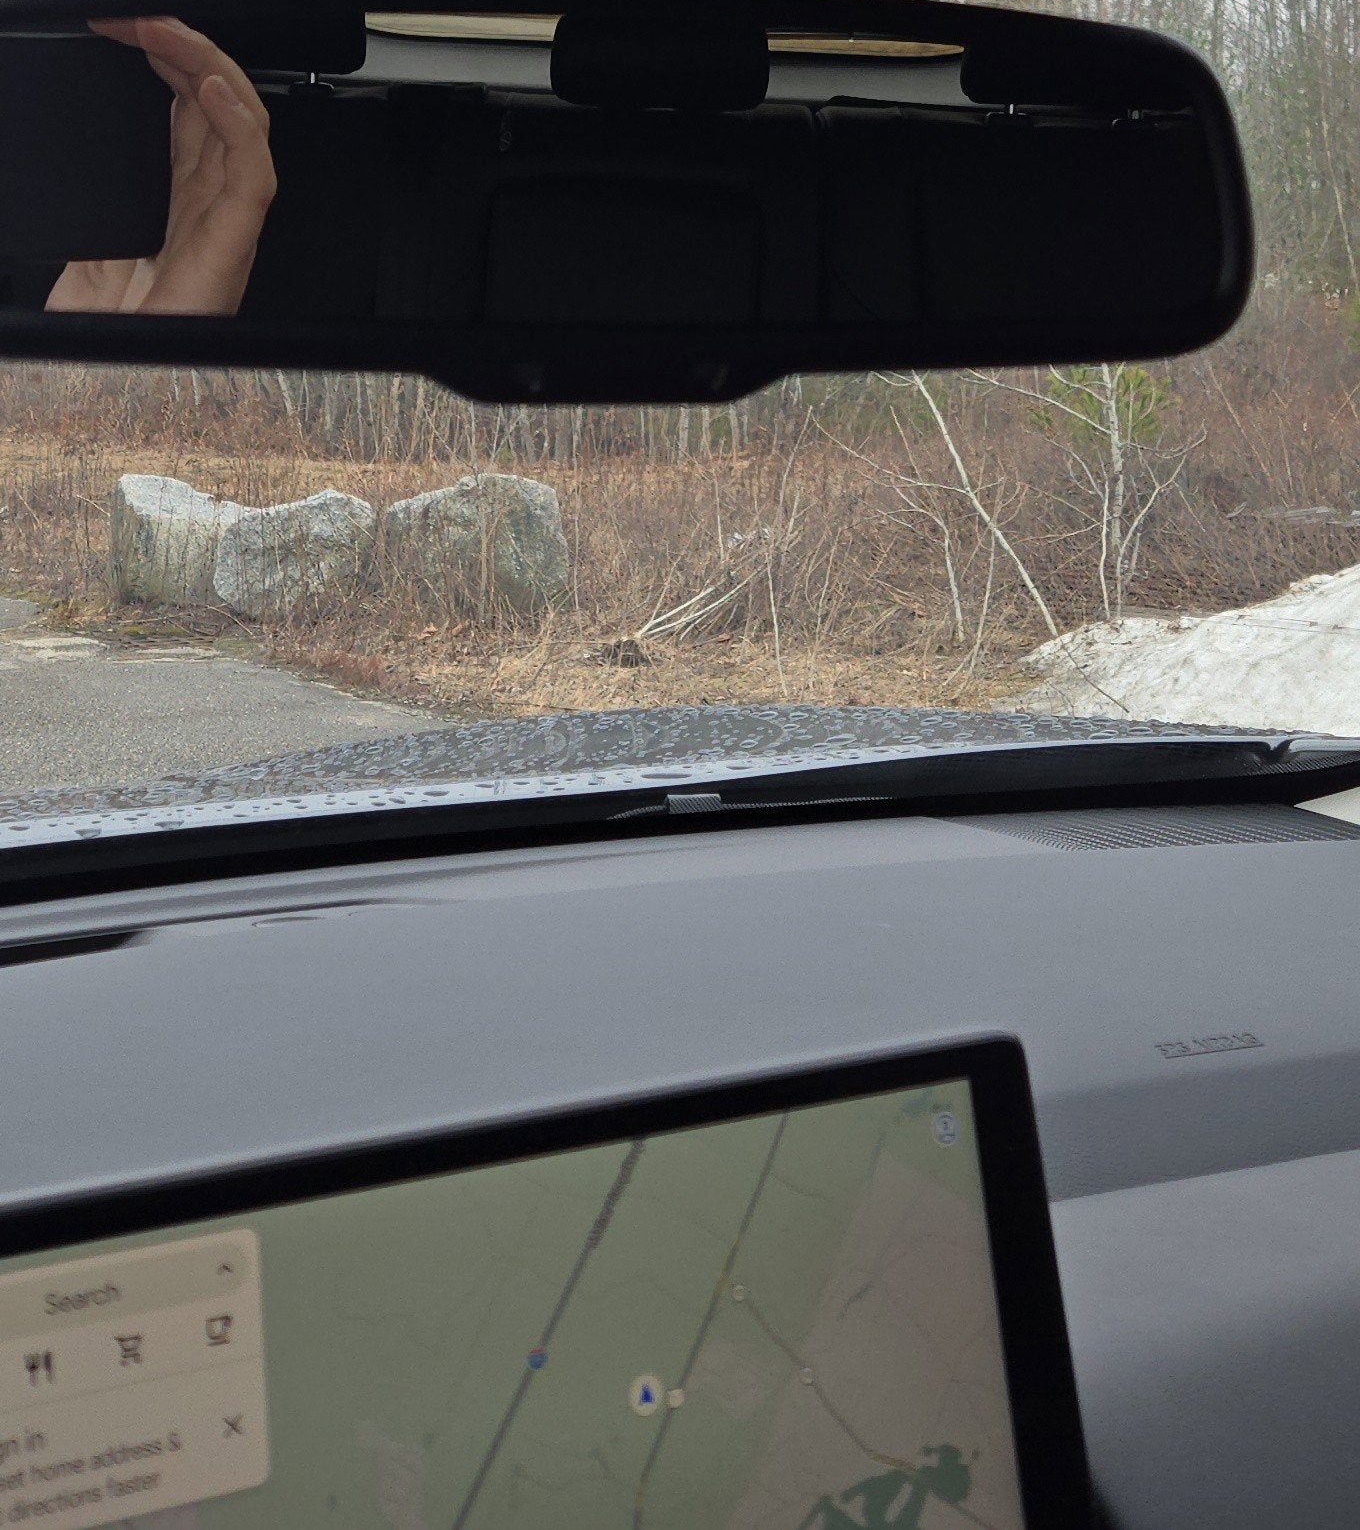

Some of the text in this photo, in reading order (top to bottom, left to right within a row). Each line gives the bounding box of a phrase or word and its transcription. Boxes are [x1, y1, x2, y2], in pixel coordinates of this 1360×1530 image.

[43, 1282, 123, 1316] Search
[23, 1429, 46, 1453] in
[30, 1459, 84, 1483] home
[90, 1440, 162, 1471] address
[7, 1487, 102, 1523] directions
[105, 1472, 160, 1498] faster
